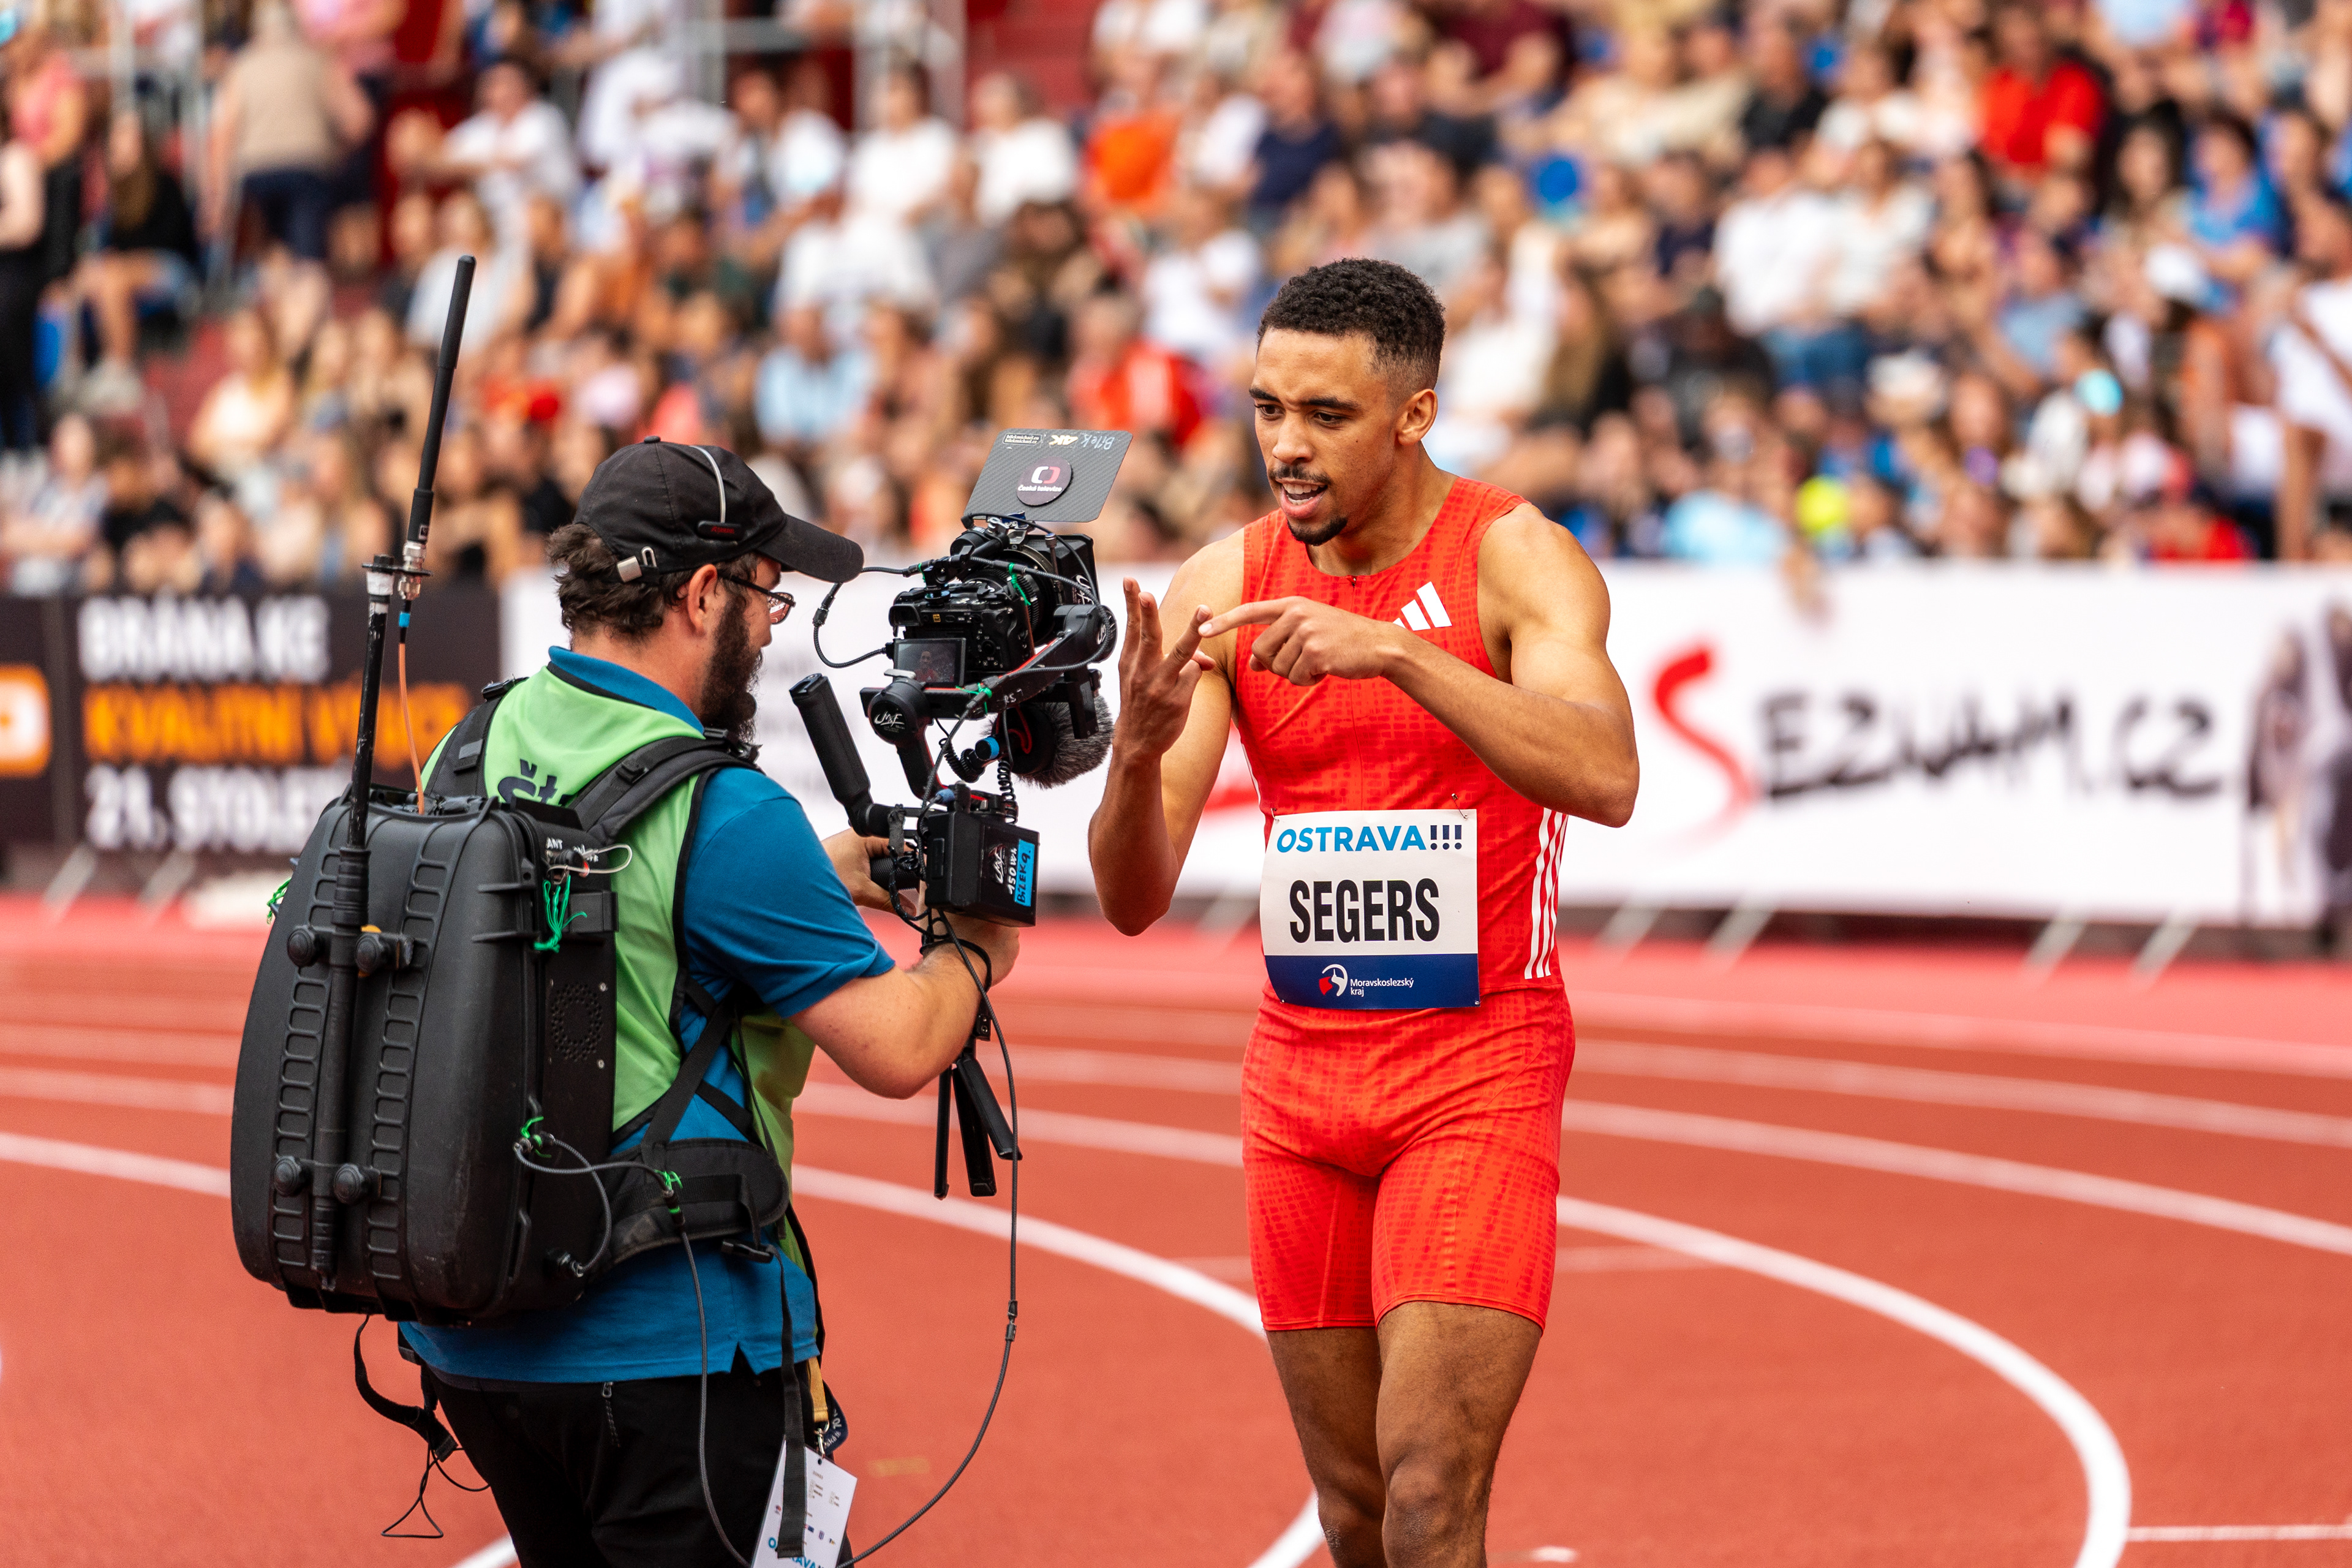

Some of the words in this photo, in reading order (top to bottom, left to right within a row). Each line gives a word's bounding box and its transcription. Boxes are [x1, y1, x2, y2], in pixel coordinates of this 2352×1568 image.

[546, 837, 562, 850] ANT
[1277, 824, 1462, 853] OSTRAVA!!!
[1289, 878, 1439, 943] SEGERS
[1350, 978, 1414, 988] Moravskoslezský
[1351, 987, 1364, 997] kraj
